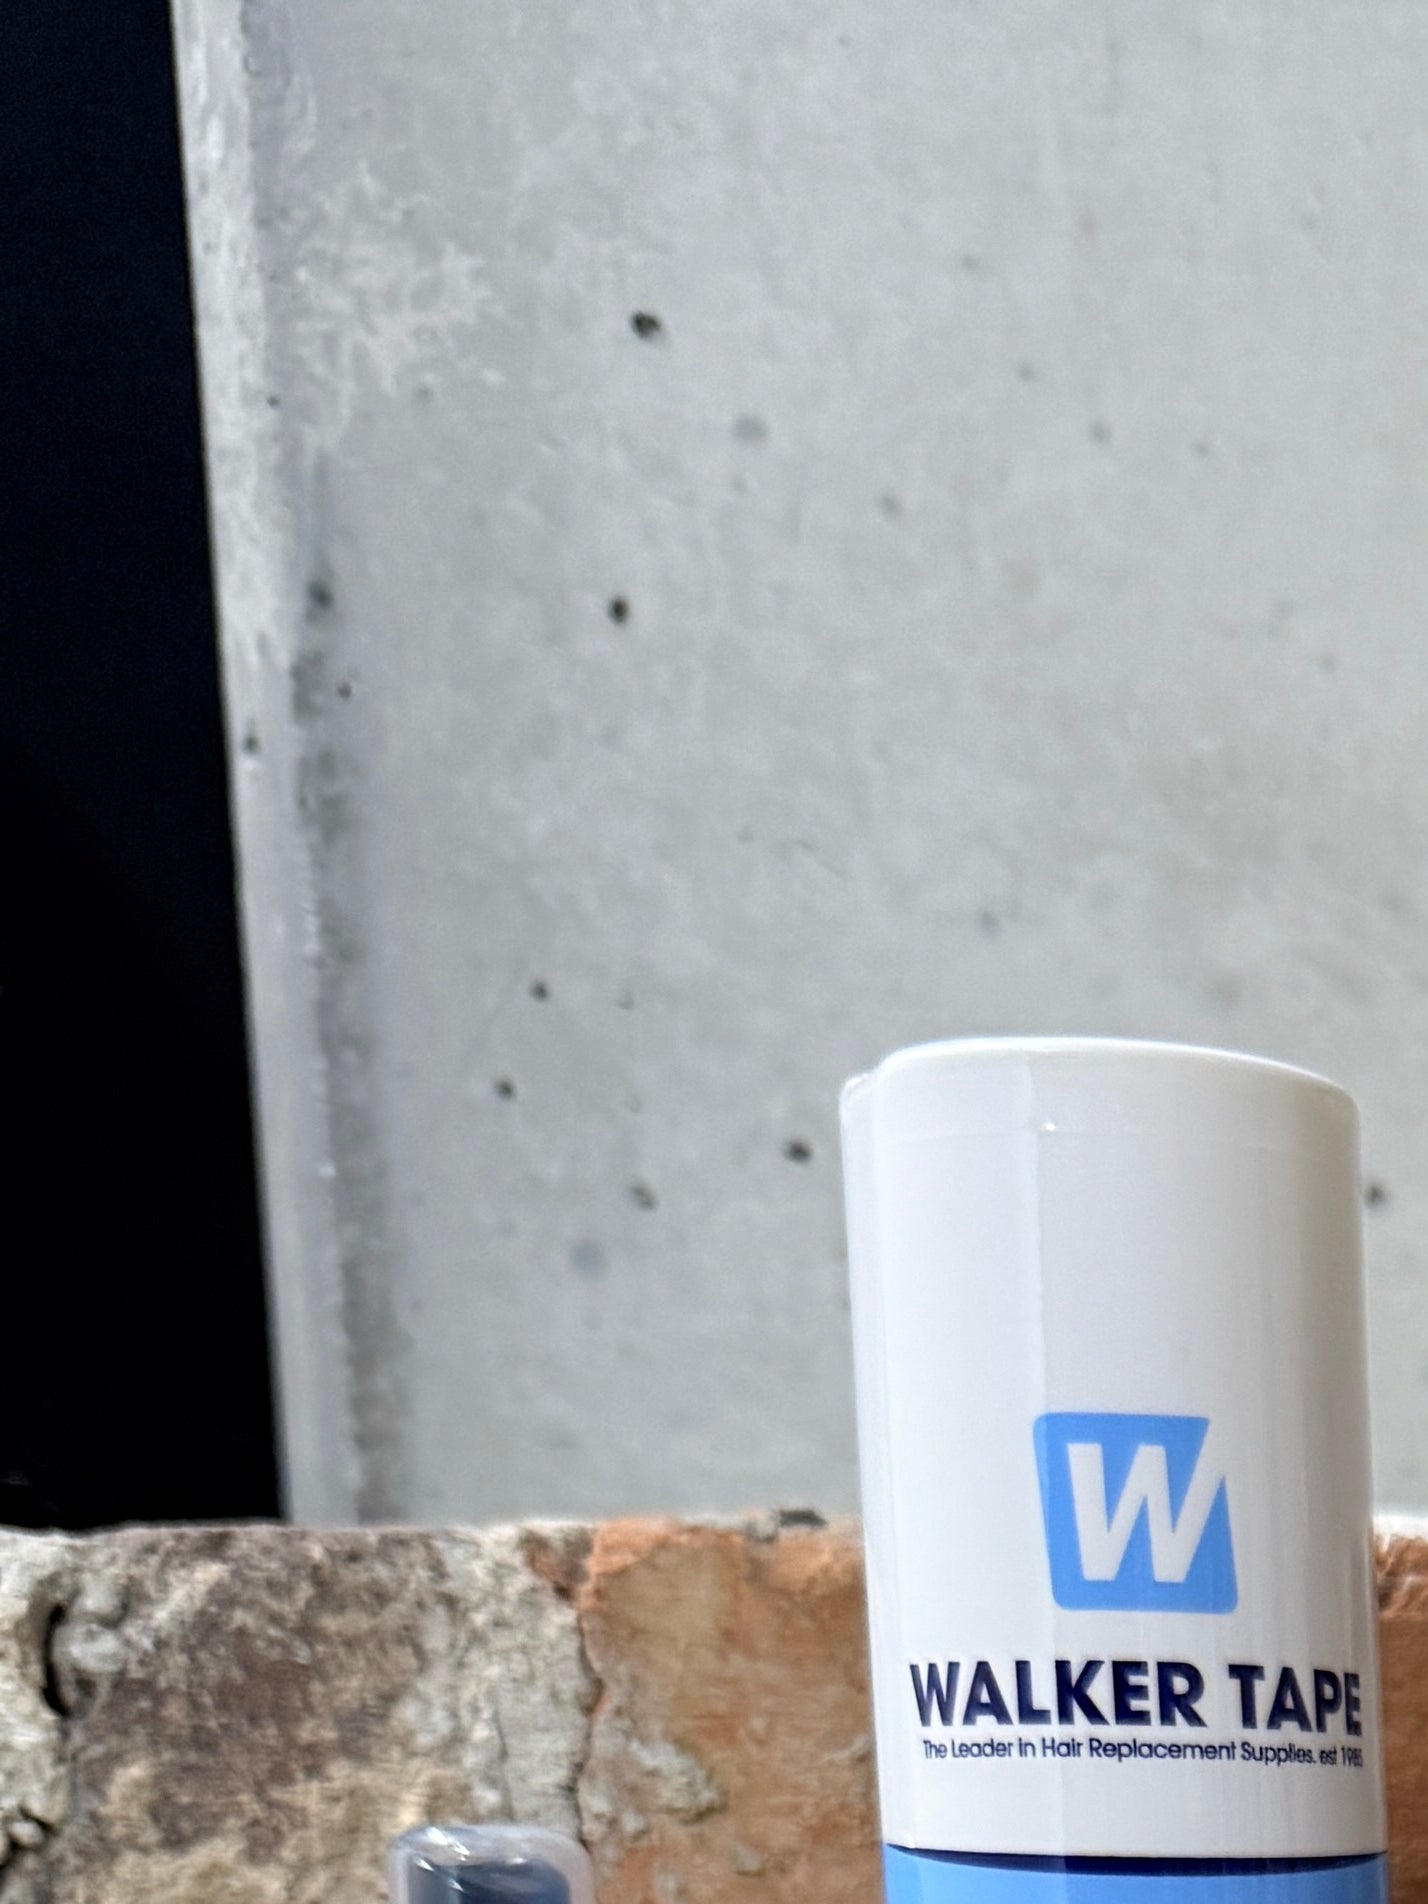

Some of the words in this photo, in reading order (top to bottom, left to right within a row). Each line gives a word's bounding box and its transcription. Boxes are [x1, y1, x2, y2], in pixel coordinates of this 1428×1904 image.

[910, 1659, 1208, 1728] WALKER
[1228, 1663, 1362, 1736] TAPE
[923, 1738, 947, 1760] The
[951, 1738, 1013, 1760] Leader
[1018, 1737, 1036, 1758] in
[1042, 1737, 1082, 1759] Hair
[1089, 1739, 1236, 1763] Replacement
